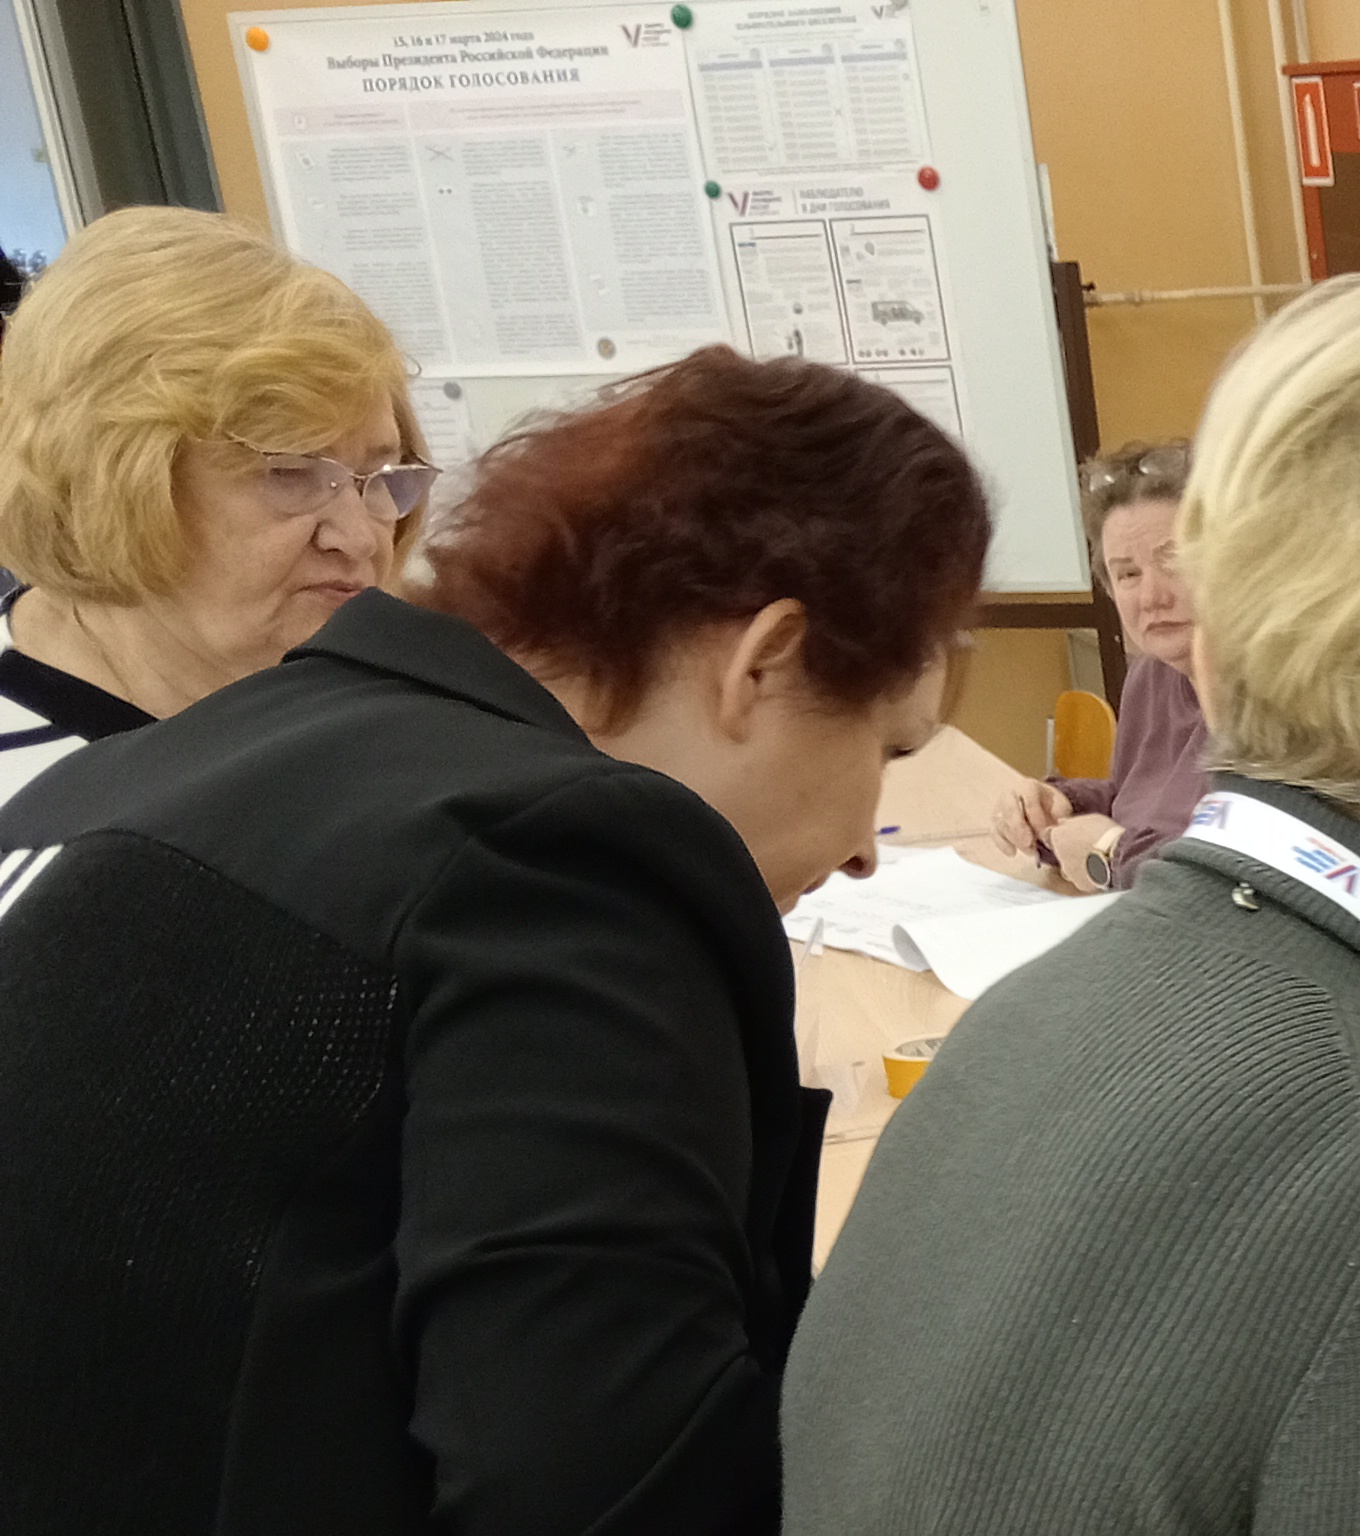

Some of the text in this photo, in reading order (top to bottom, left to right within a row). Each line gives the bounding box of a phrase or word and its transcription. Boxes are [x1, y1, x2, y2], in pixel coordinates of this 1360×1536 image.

[327, 45, 609, 70] Выборы Президента Российской Федерации
[363, 68, 580, 92] ПОРЯДОК ГОЛОСОВАНИЯ
